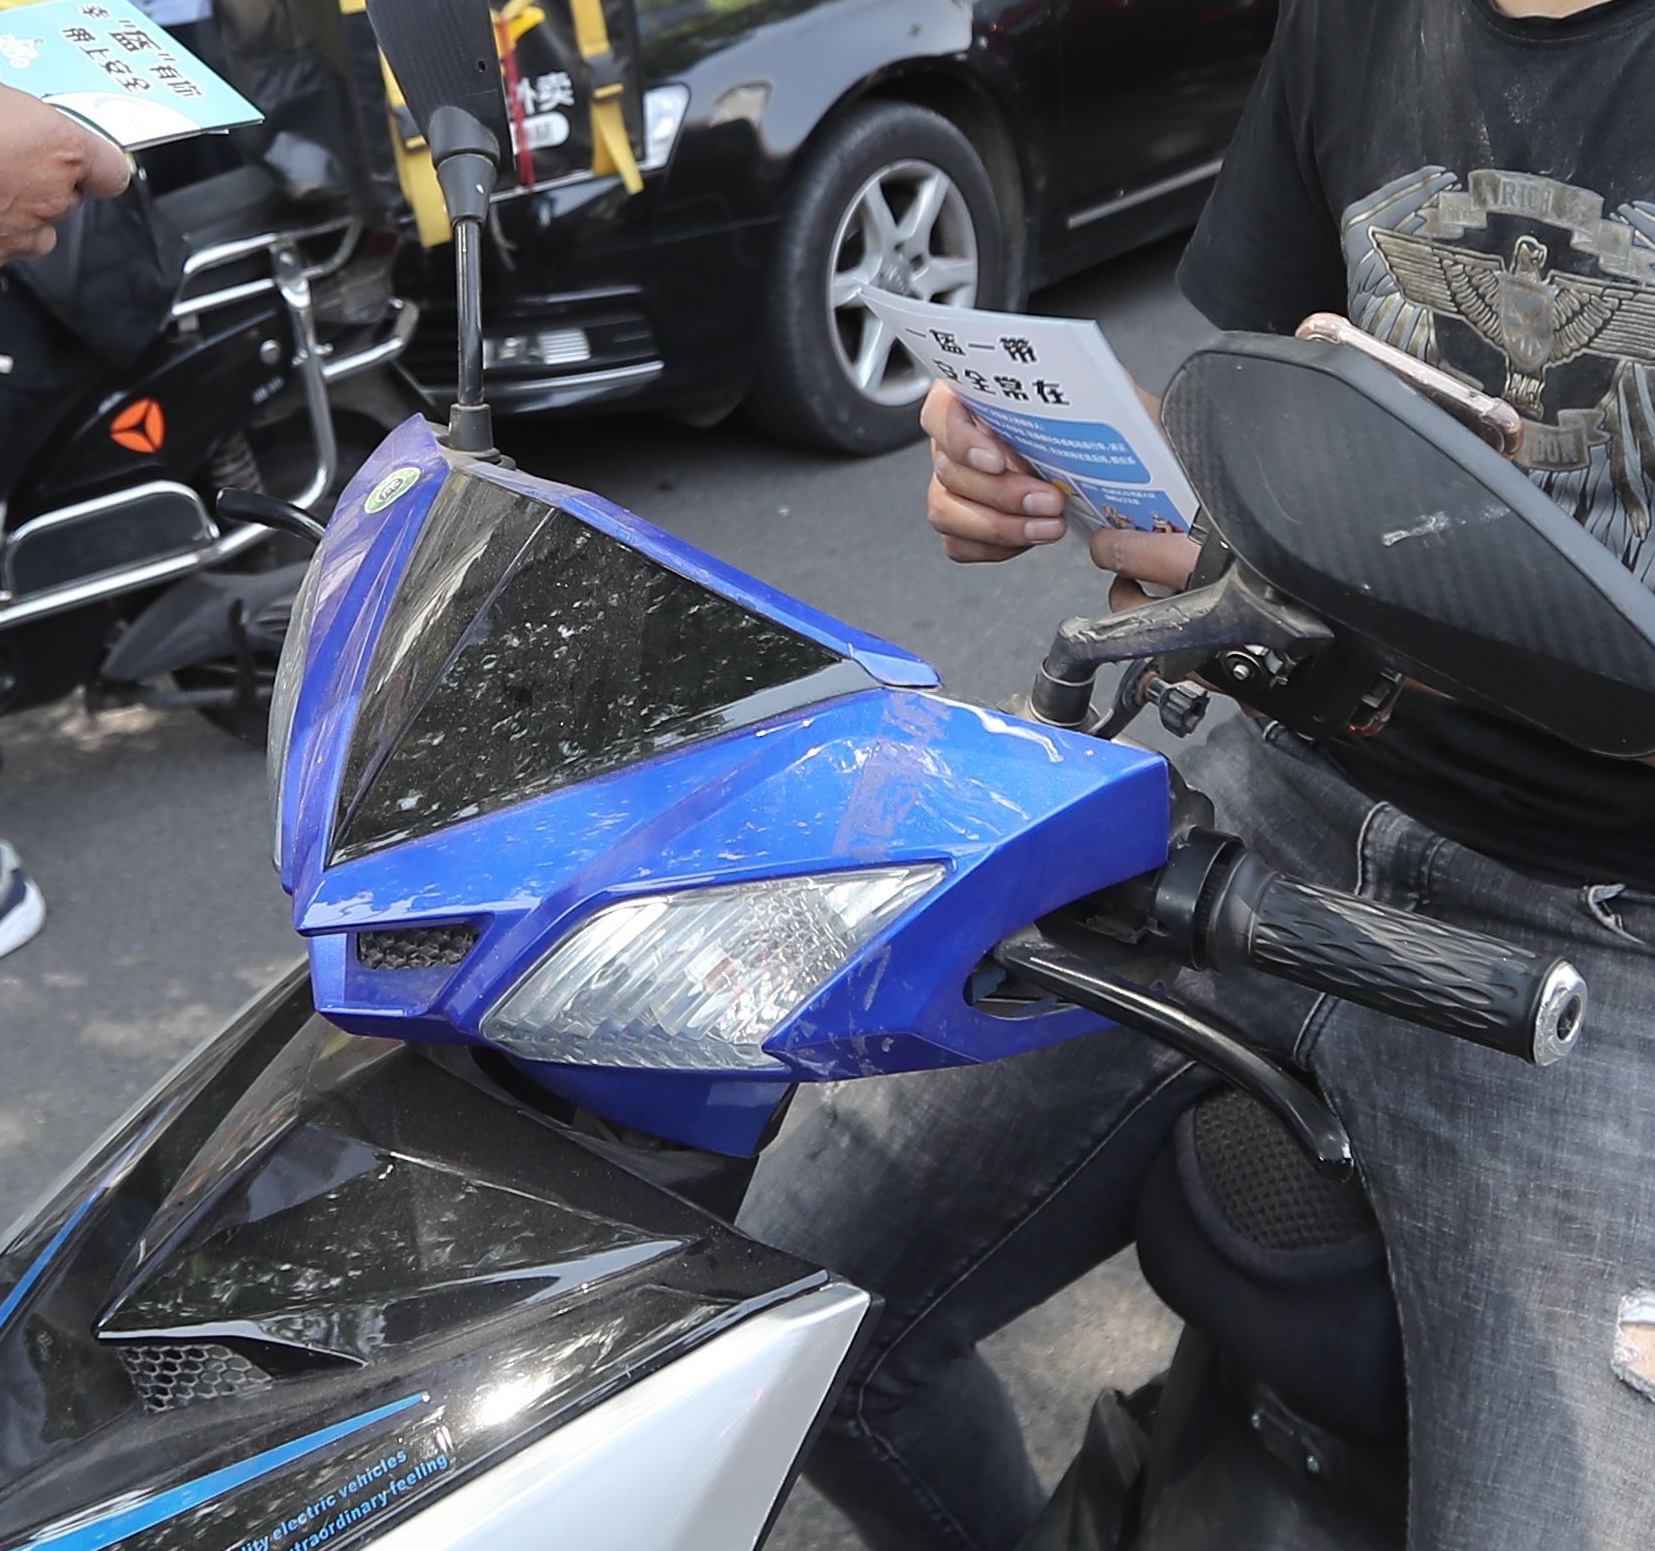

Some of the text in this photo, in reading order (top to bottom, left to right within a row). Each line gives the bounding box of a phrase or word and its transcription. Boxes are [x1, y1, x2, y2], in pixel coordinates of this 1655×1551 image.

[272, 1494, 337, 1541] electric
[338, 1449, 407, 1498] vehicles
[290, 1453, 449, 1551] traordinary feeling
